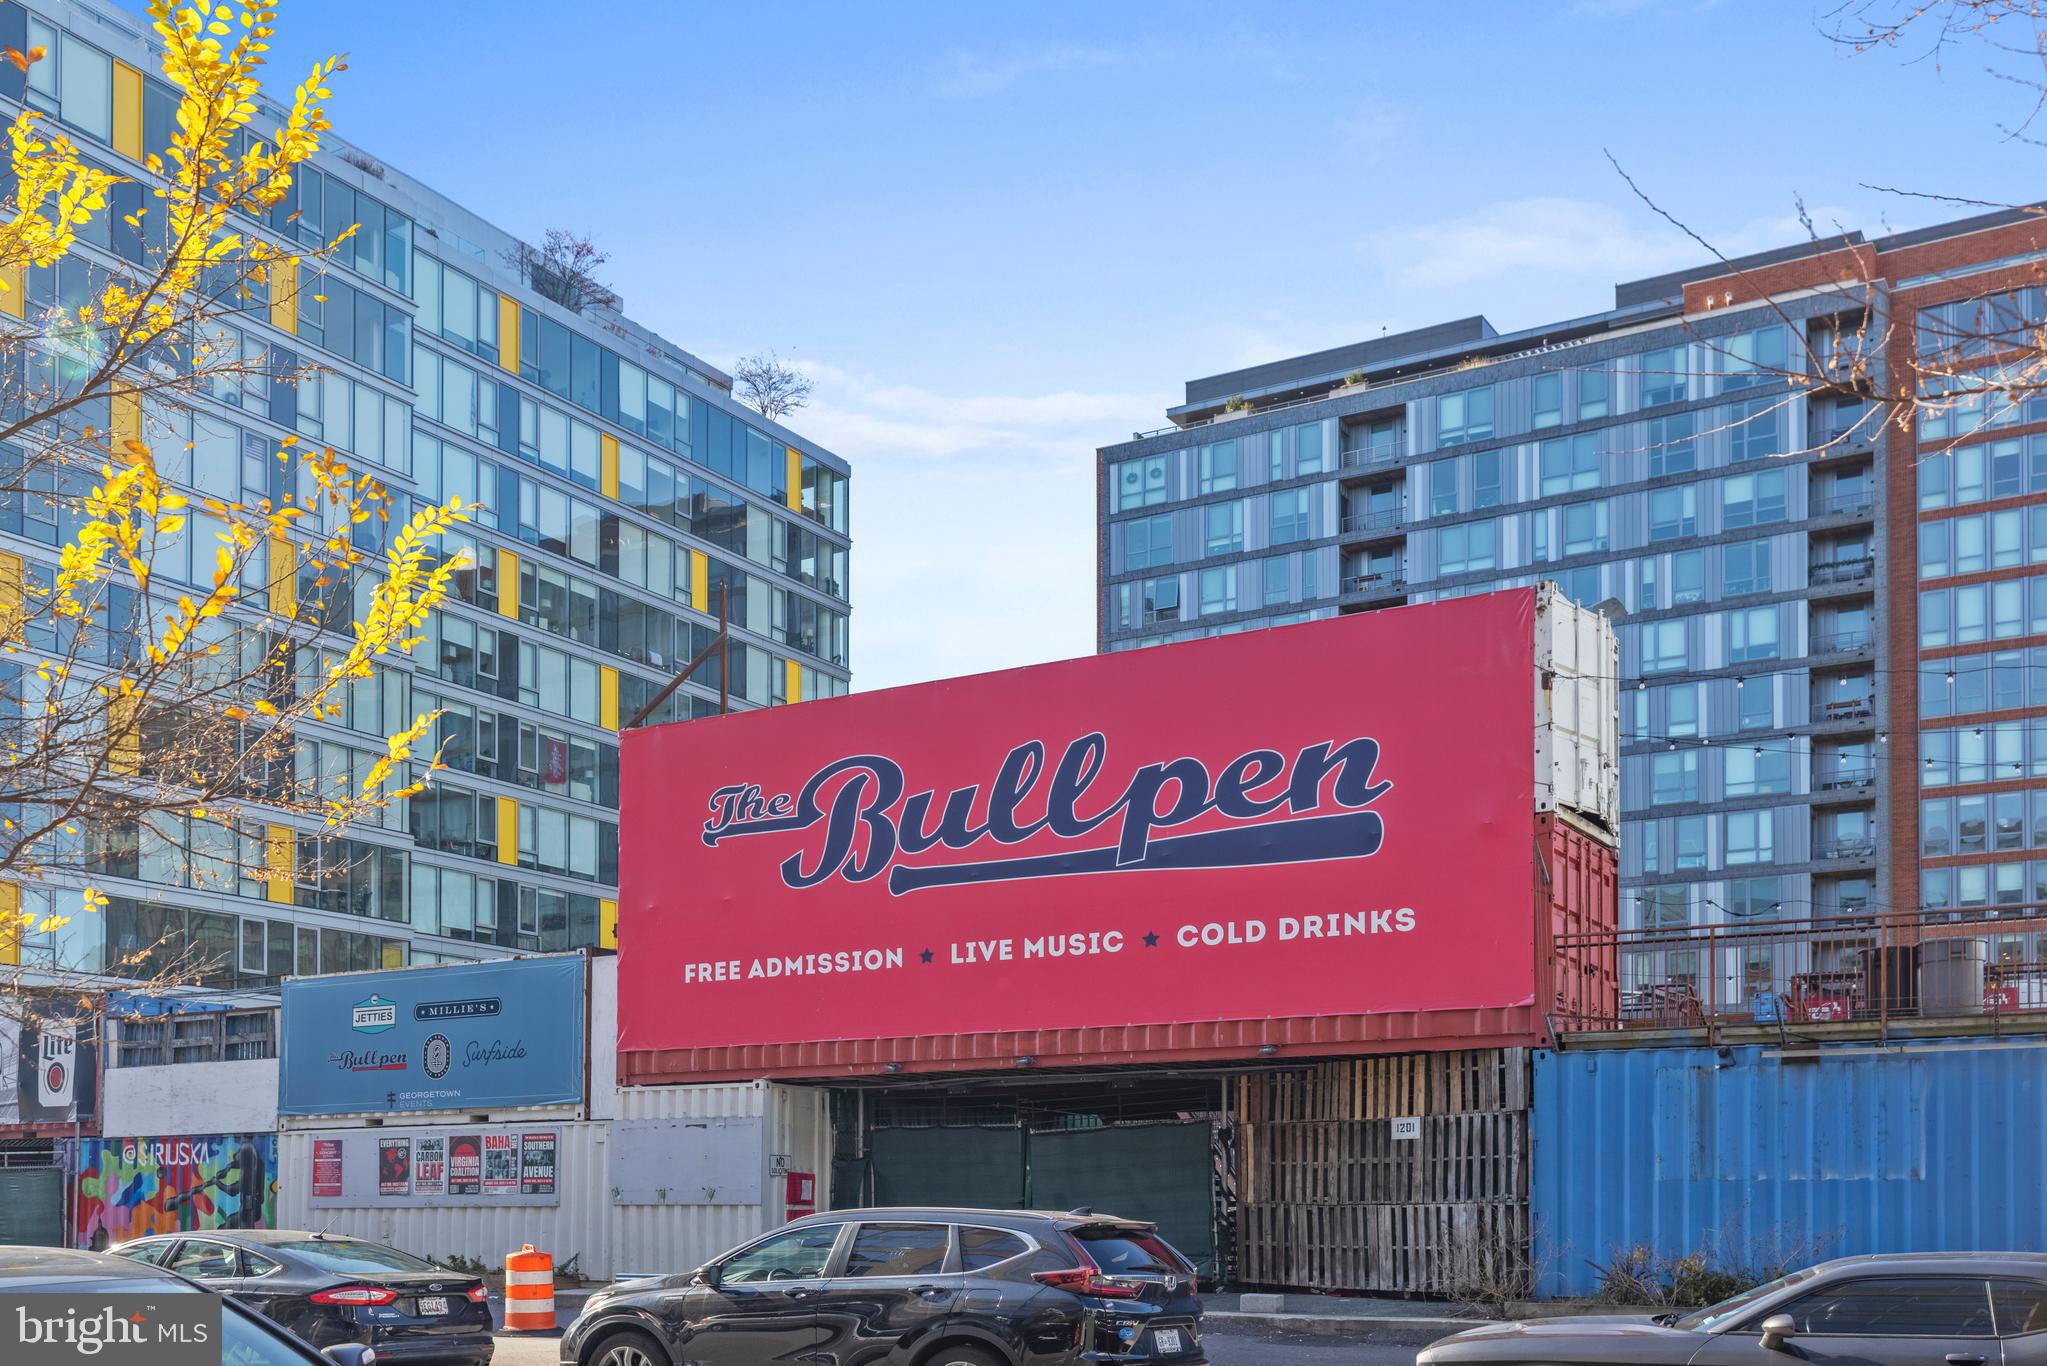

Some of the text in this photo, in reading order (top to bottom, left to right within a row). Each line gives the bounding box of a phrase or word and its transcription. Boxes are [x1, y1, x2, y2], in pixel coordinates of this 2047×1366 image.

[703, 731, 1394, 889] The Bullpen
[684, 906, 1417, 984] FREE ADMISSION LIVE MUSIC COLD DRINKS
[429, 1003, 488, 1016] MILLIE'S
[355, 1011, 393, 1023] JETTIES
[42, 1035, 73, 1061] Lite
[462, 1040, 527, 1068] Surfside
[399, 1089, 461, 1100] GEORGETOWN
[1396, 1122, 1415, 1133] 1201
[380, 1139, 409, 1148] EVERYTHING
[485, 1135, 511, 1149] BAHA
[523, 1141, 554, 1150] SOUTHERN
[416, 1151, 444, 1162] CARBON
[450, 1156, 480, 1167] VIRGINIA
[776, 1157, 785, 1168] NO
[416, 1162, 444, 1180] LEAF
[450, 1168, 480, 1177] COALITION
[523, 1166, 553, 1178] AVENUE
